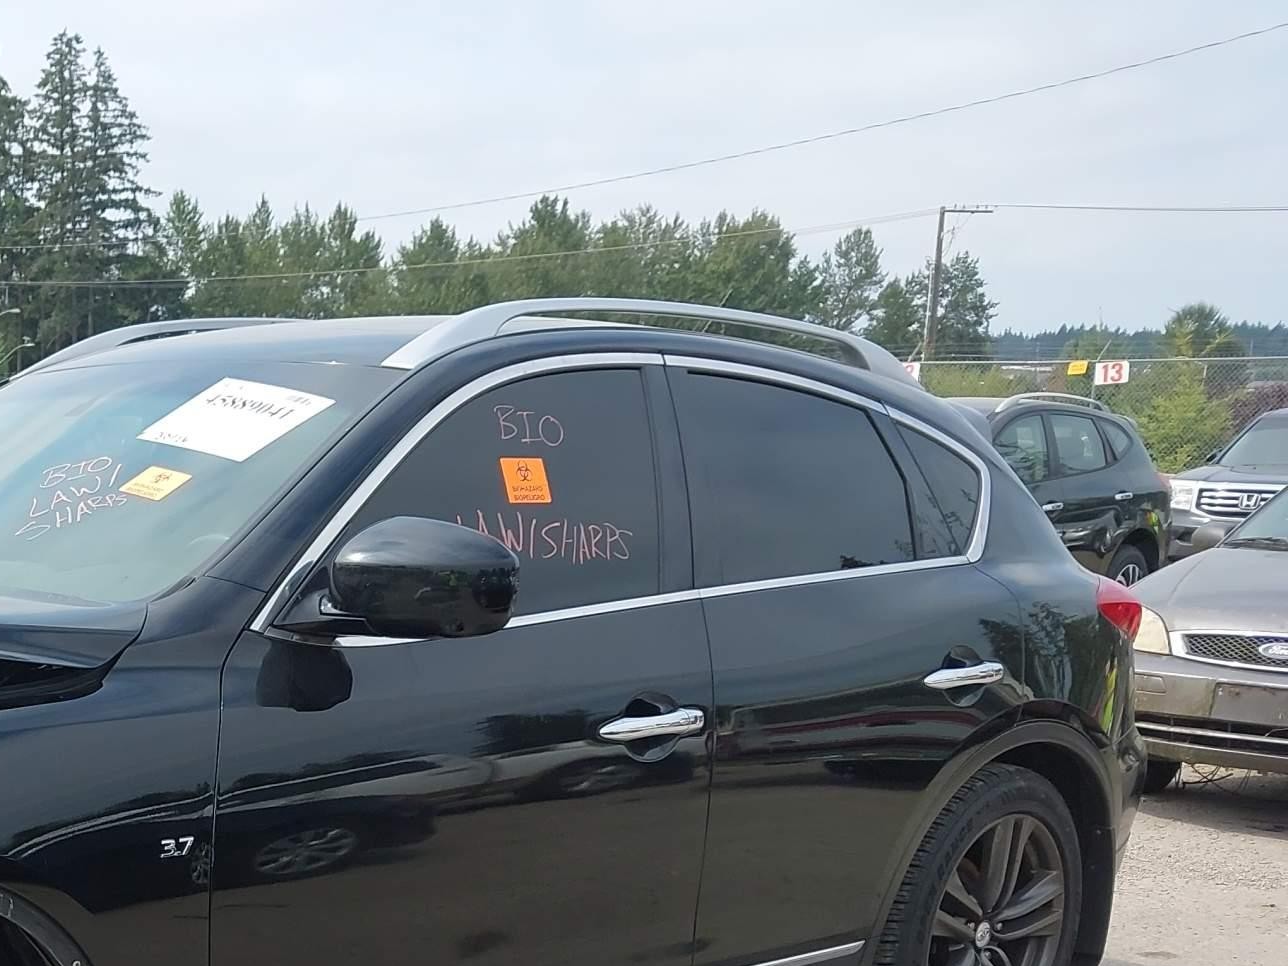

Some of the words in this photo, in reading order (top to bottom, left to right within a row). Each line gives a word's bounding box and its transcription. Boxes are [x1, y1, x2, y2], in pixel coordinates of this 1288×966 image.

[1101, 362, 1124, 383] 13
[206, 394, 295, 419] 45889041
[493, 404, 564, 447] BIO
[39, 456, 113, 488] BIO
[14, 494, 128, 541] SHARPS
